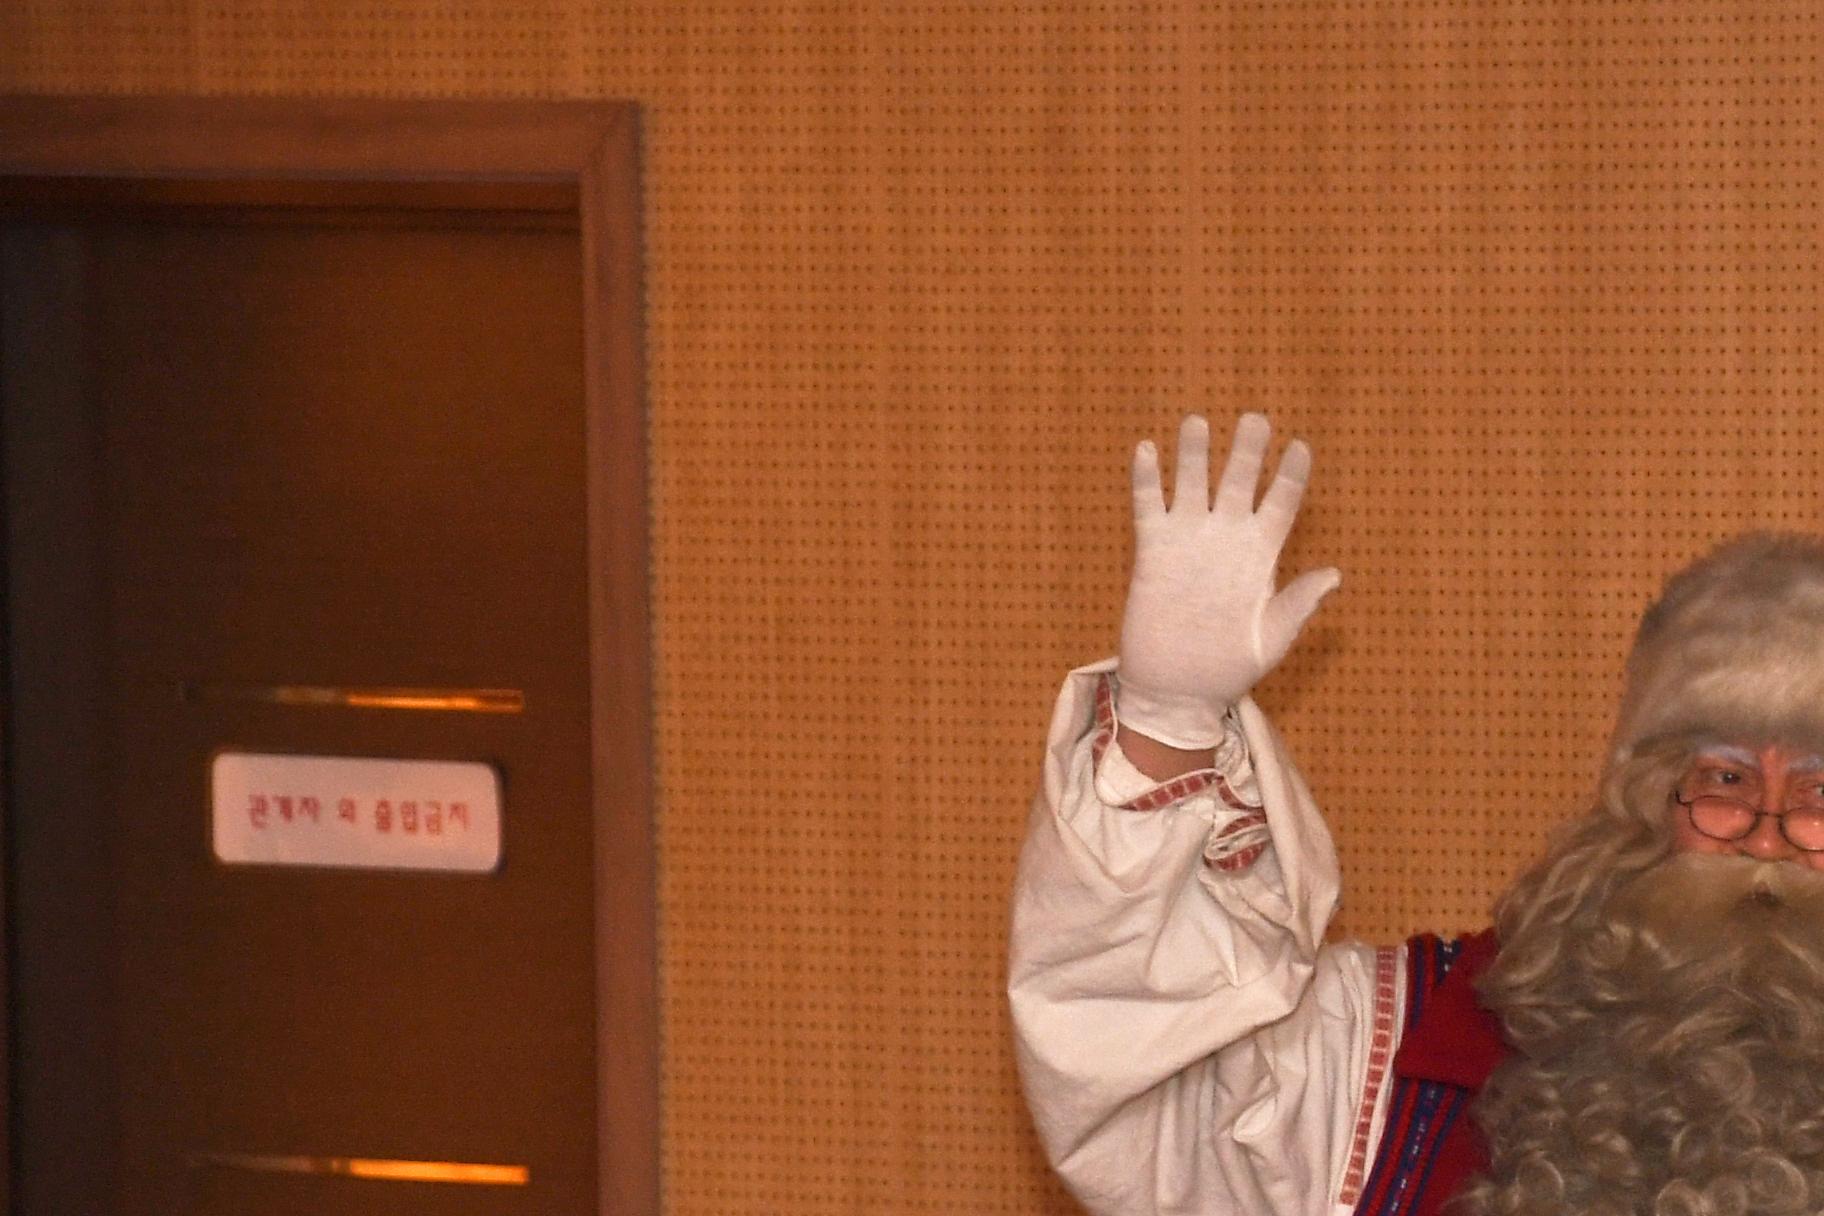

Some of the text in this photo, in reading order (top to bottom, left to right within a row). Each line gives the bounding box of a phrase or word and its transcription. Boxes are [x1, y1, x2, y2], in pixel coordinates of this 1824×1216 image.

[248, 794, 470, 835] 관계자 외 출입금지
